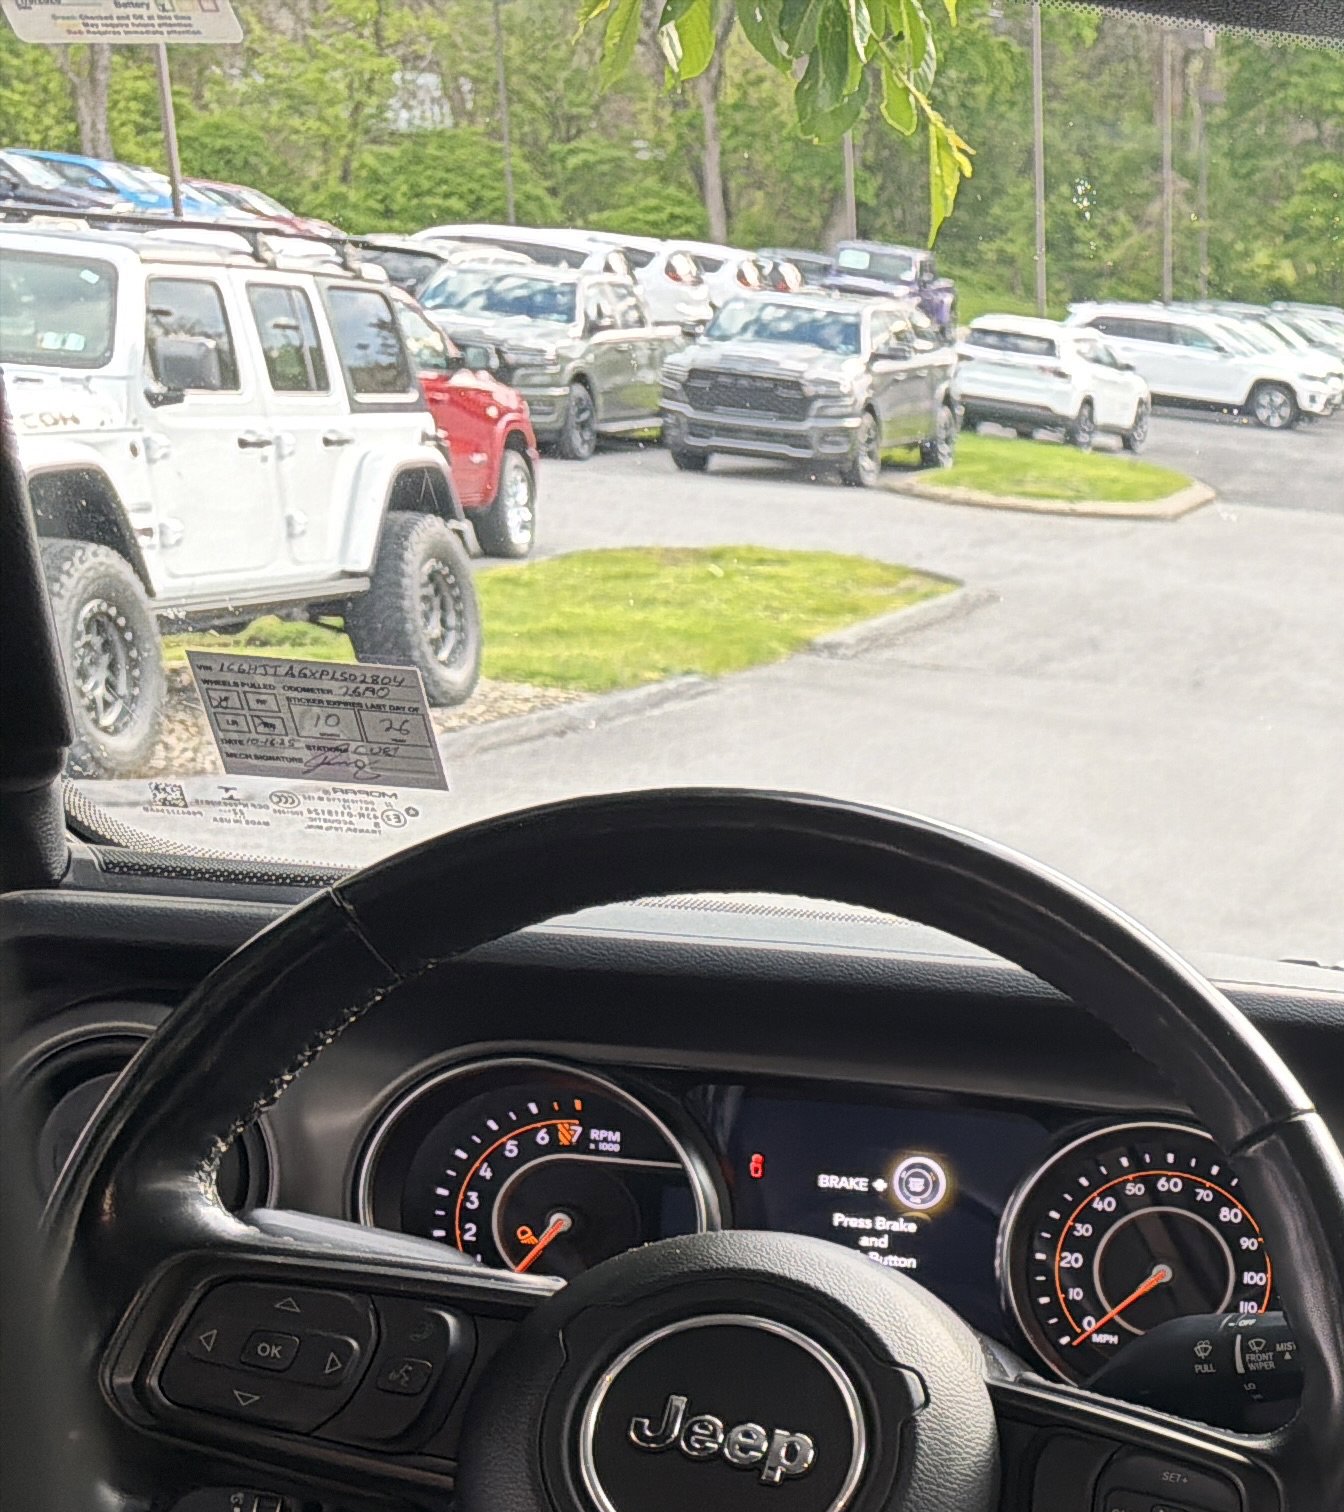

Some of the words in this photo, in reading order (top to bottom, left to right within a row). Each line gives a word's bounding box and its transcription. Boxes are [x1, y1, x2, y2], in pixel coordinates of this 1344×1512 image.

[313, 713, 341, 728] 10
[380, 718, 410, 735] 26
[536, 1127, 549, 1145] 6
[570, 1126, 583, 1143] 7
[589, 1129, 621, 1142] RPM
[504, 1140, 519, 1158] 5
[479, 1162, 492, 1180] 4
[817, 1174, 869, 1191] BRAKE
[1125, 1183, 1145, 1196] 50
[1157, 1178, 1183, 1192] 60
[466, 1191, 479, 1209] 3
[1195, 1188, 1213, 1202] 70
[1092, 1197, 1116, 1212] 40
[832, 1212, 872, 1229] Press
[875, 1216, 918, 1233] Brake
[1219, 1207, 1243, 1224] 80
[463, 1222, 477, 1241] 2
[1073, 1223, 1093, 1237] 30
[858, 1234, 888, 1248] and
[1239, 1237, 1258, 1251] 90
[1060, 1252, 1083, 1268] 20
[1243, 1272, 1266, 1285] 100
[1068, 1288, 1084, 1301] 10
[1239, 1301, 1258, 1314] 110
[1082, 1315, 1096, 1331] 0
[1091, 1332, 1119, 1345] MPH
[257, 1342, 282, 1359] OK
[1246, 1353, 1274, 1363] FRONT
[1194, 1364, 1216, 1374] PULL
[1248, 1361, 1276, 1371] WIPER
[629, 1394, 816, 1486] Jeep
